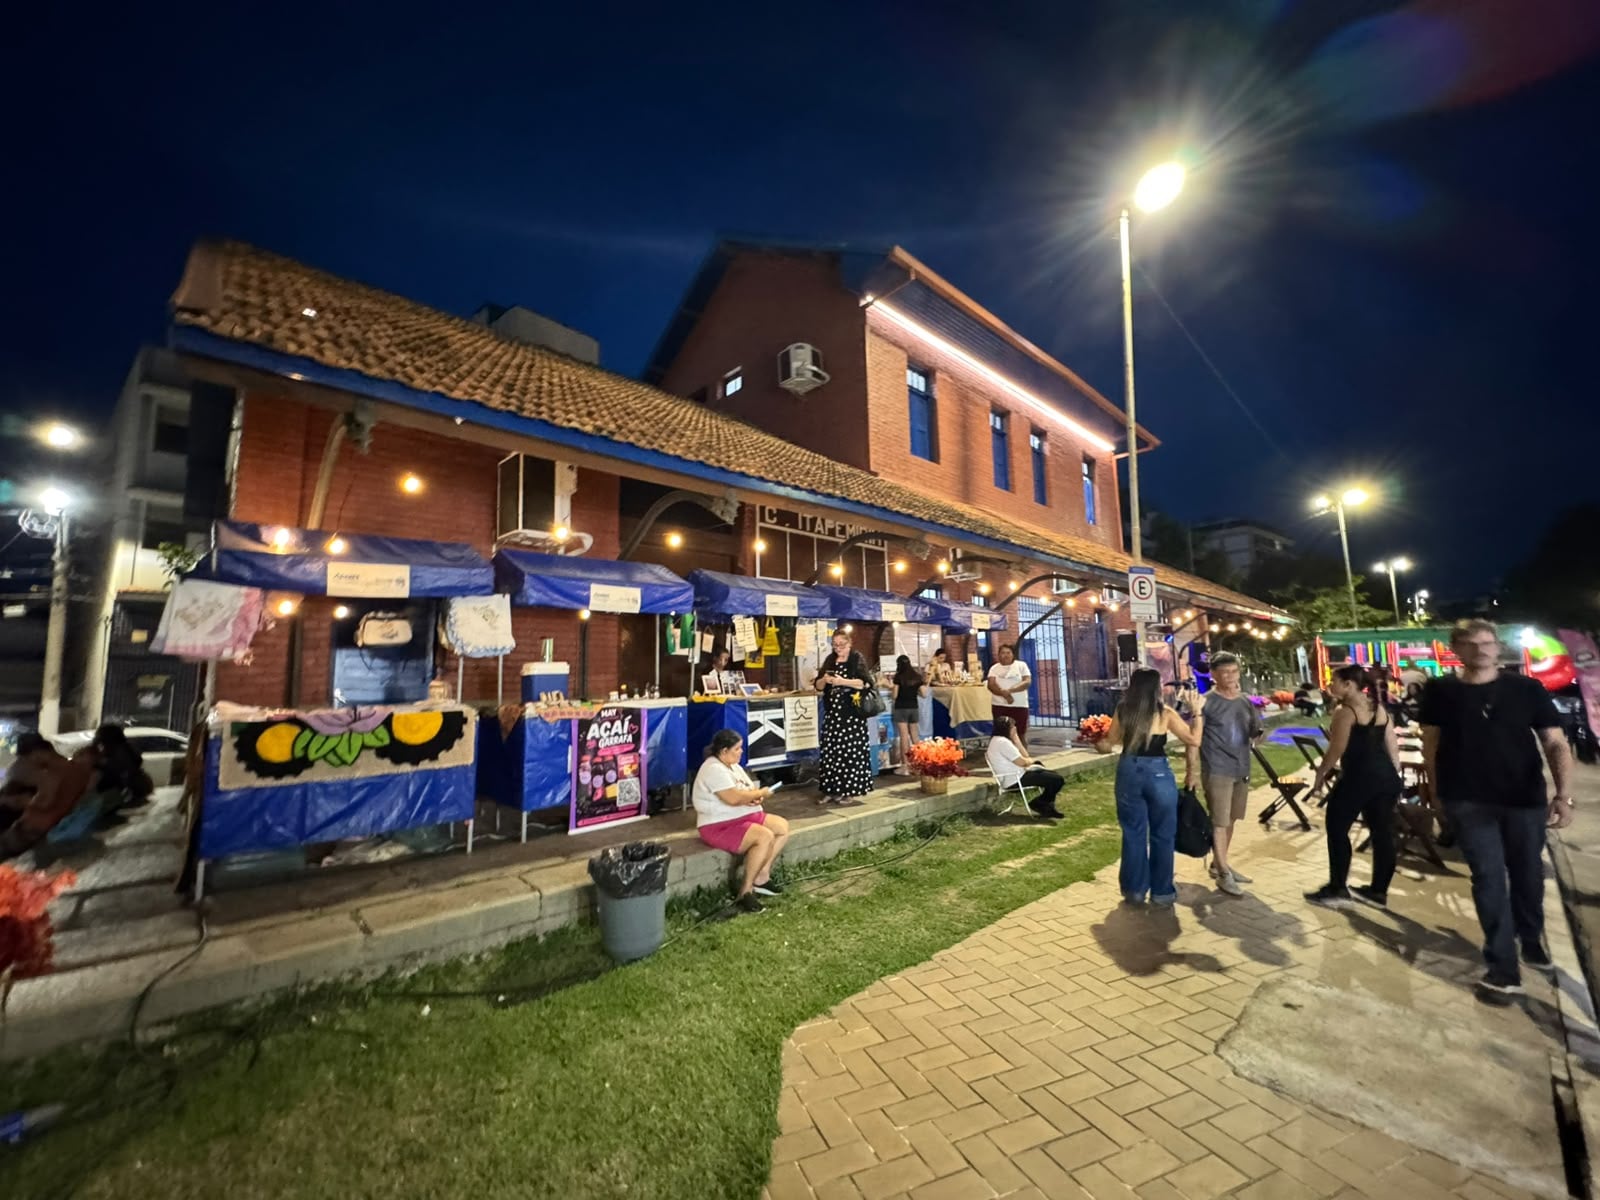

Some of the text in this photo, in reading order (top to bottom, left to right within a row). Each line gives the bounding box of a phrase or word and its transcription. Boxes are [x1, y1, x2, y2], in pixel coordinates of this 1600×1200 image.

[1138, 580, 1147, 596] E
[586, 714, 632, 740] AÇAÍ
[598, 733, 633, 749] GARRAFA
